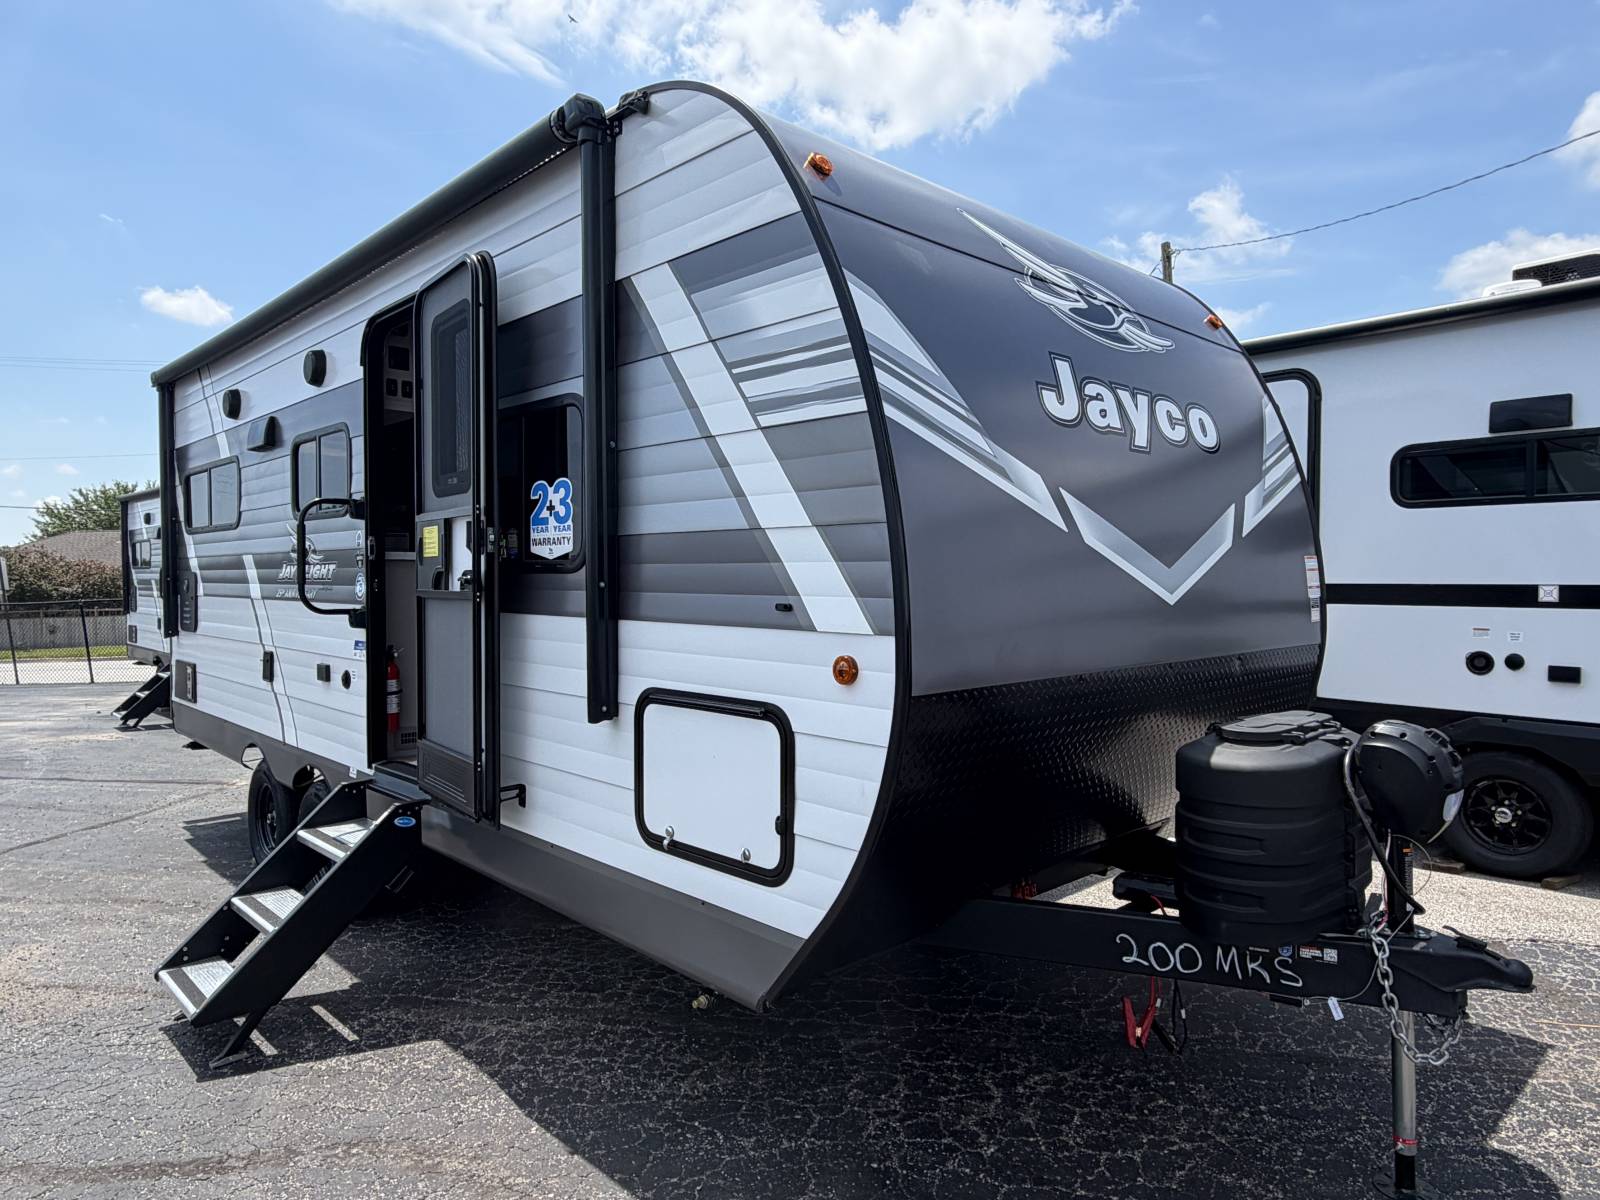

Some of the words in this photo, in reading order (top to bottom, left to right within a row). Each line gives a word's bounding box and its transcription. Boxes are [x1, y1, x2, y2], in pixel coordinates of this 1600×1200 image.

[1036, 352, 1221, 455] Jayco
[531, 526, 549, 534] YEAR
[553, 525, 571, 533] YEAR
[531, 536, 572, 547] WARRANTY
[278, 564, 297, 579] JAY
[302, 564, 337, 579] LIGHT
[1115, 933, 1203, 974] 200
